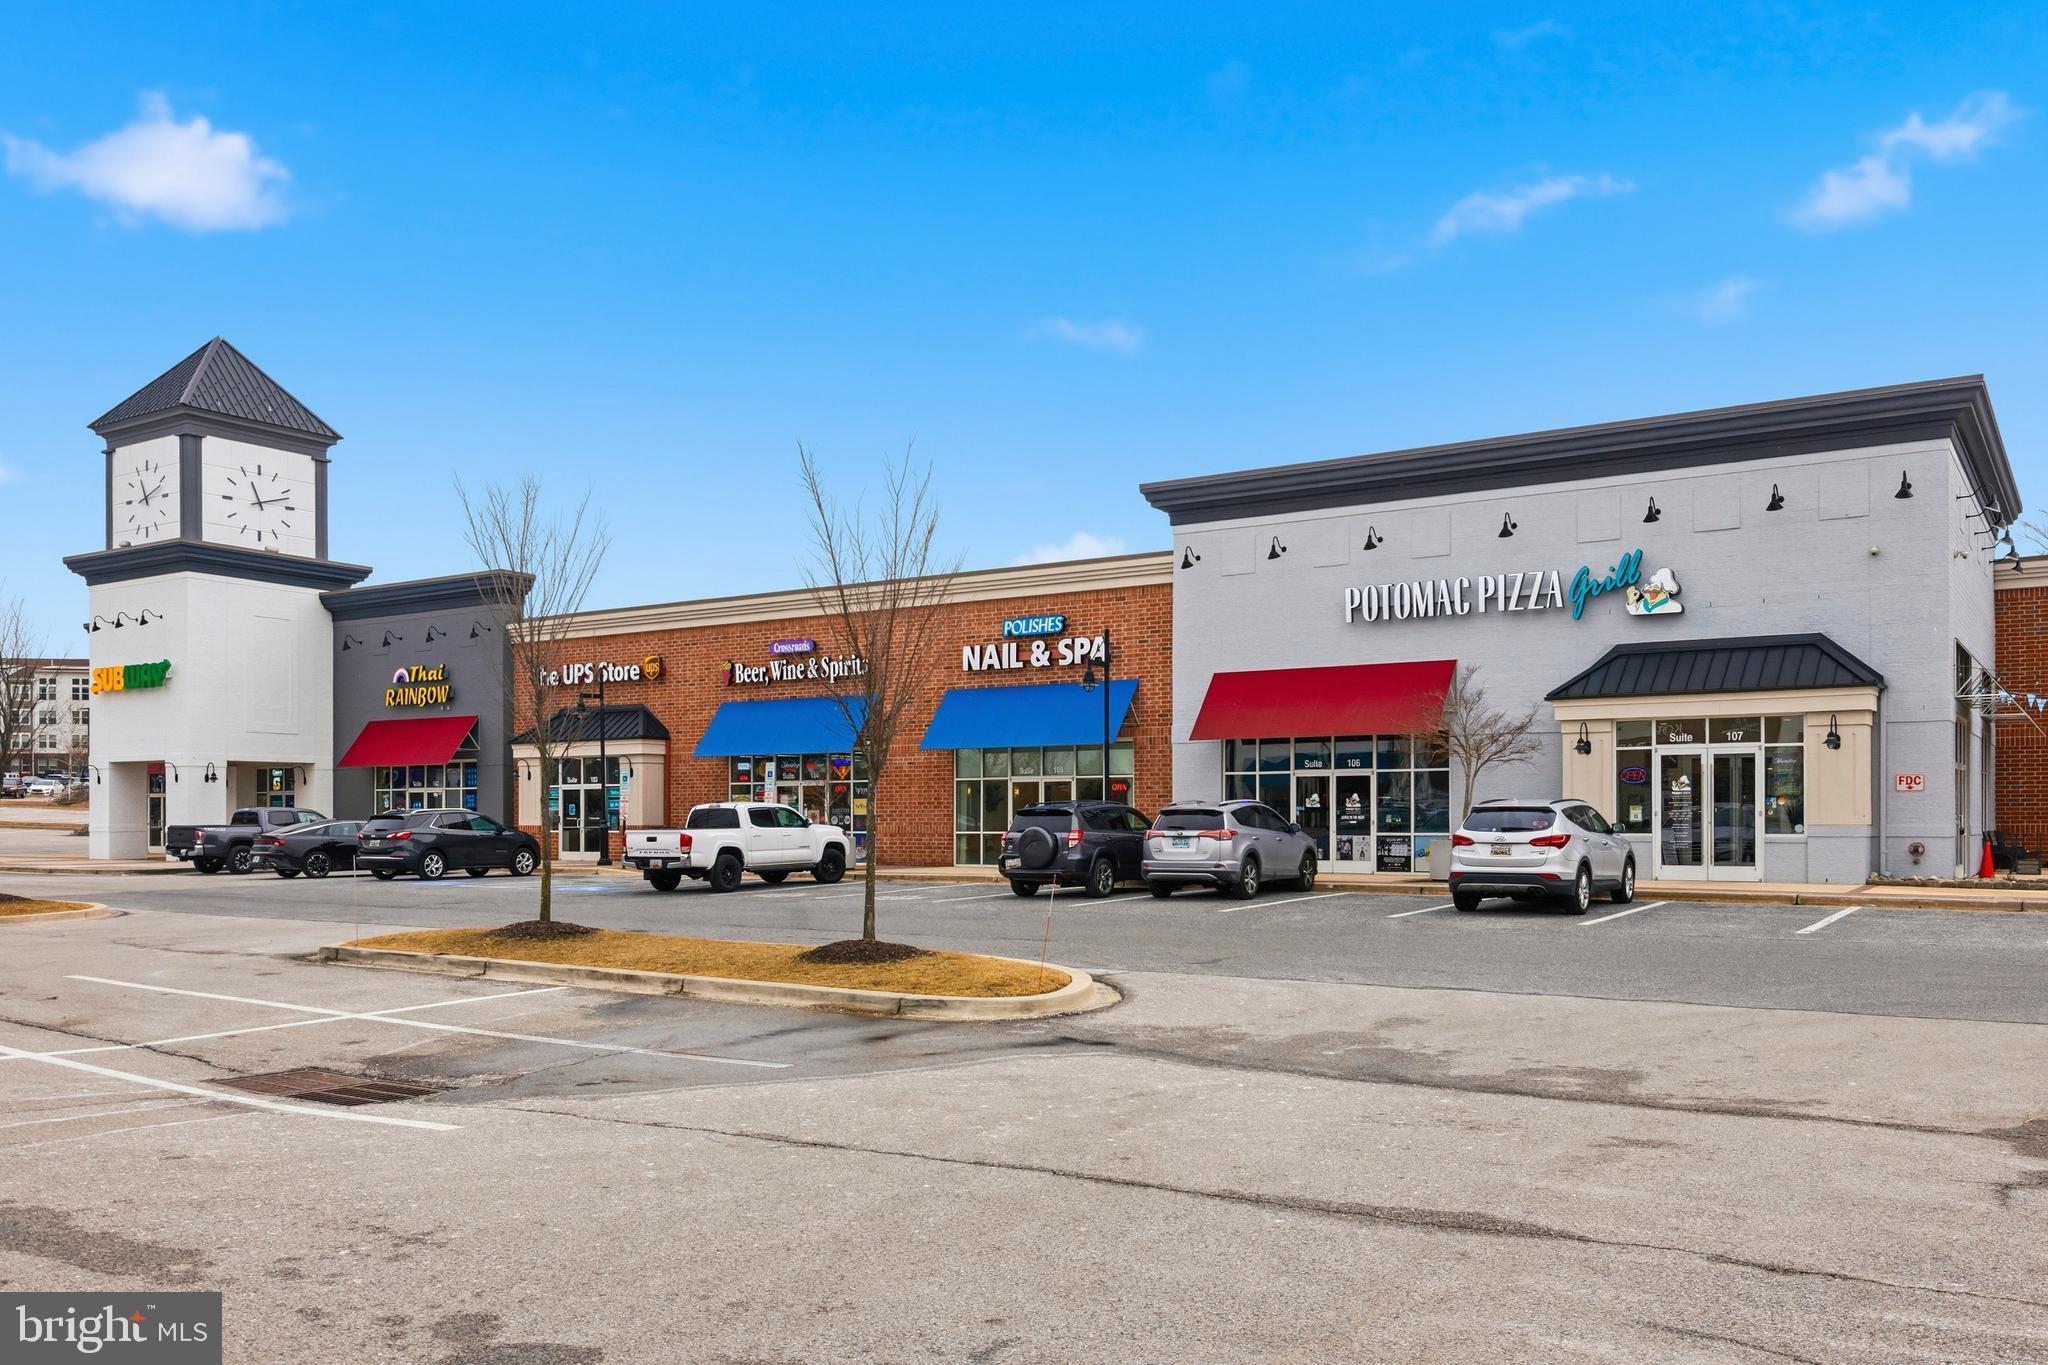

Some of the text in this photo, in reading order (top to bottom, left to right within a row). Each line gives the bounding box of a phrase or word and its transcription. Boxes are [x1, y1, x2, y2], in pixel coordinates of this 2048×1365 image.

[1345, 549, 1643, 623] POTOMAC PIZZA Grill
[1004, 616, 1065, 636] POLISHES
[962, 636, 1106, 671] NAIL & SPA
[91, 658, 171, 695] SUBWAY
[410, 663, 445, 682] Thai
[562, 662, 594, 685] UPS
[599, 661, 640, 682] Store
[645, 662, 659, 676] ups
[735, 662, 769, 685] Beer,
[770, 659, 805, 681] Wine
[807, 657, 819, 679] &
[385, 685, 449, 707] RAINBOW
[1669, 731, 1744, 742] Suite 107
[1304, 759, 1361, 768] Suite 106
[1898, 775, 1922, 786] FDC
